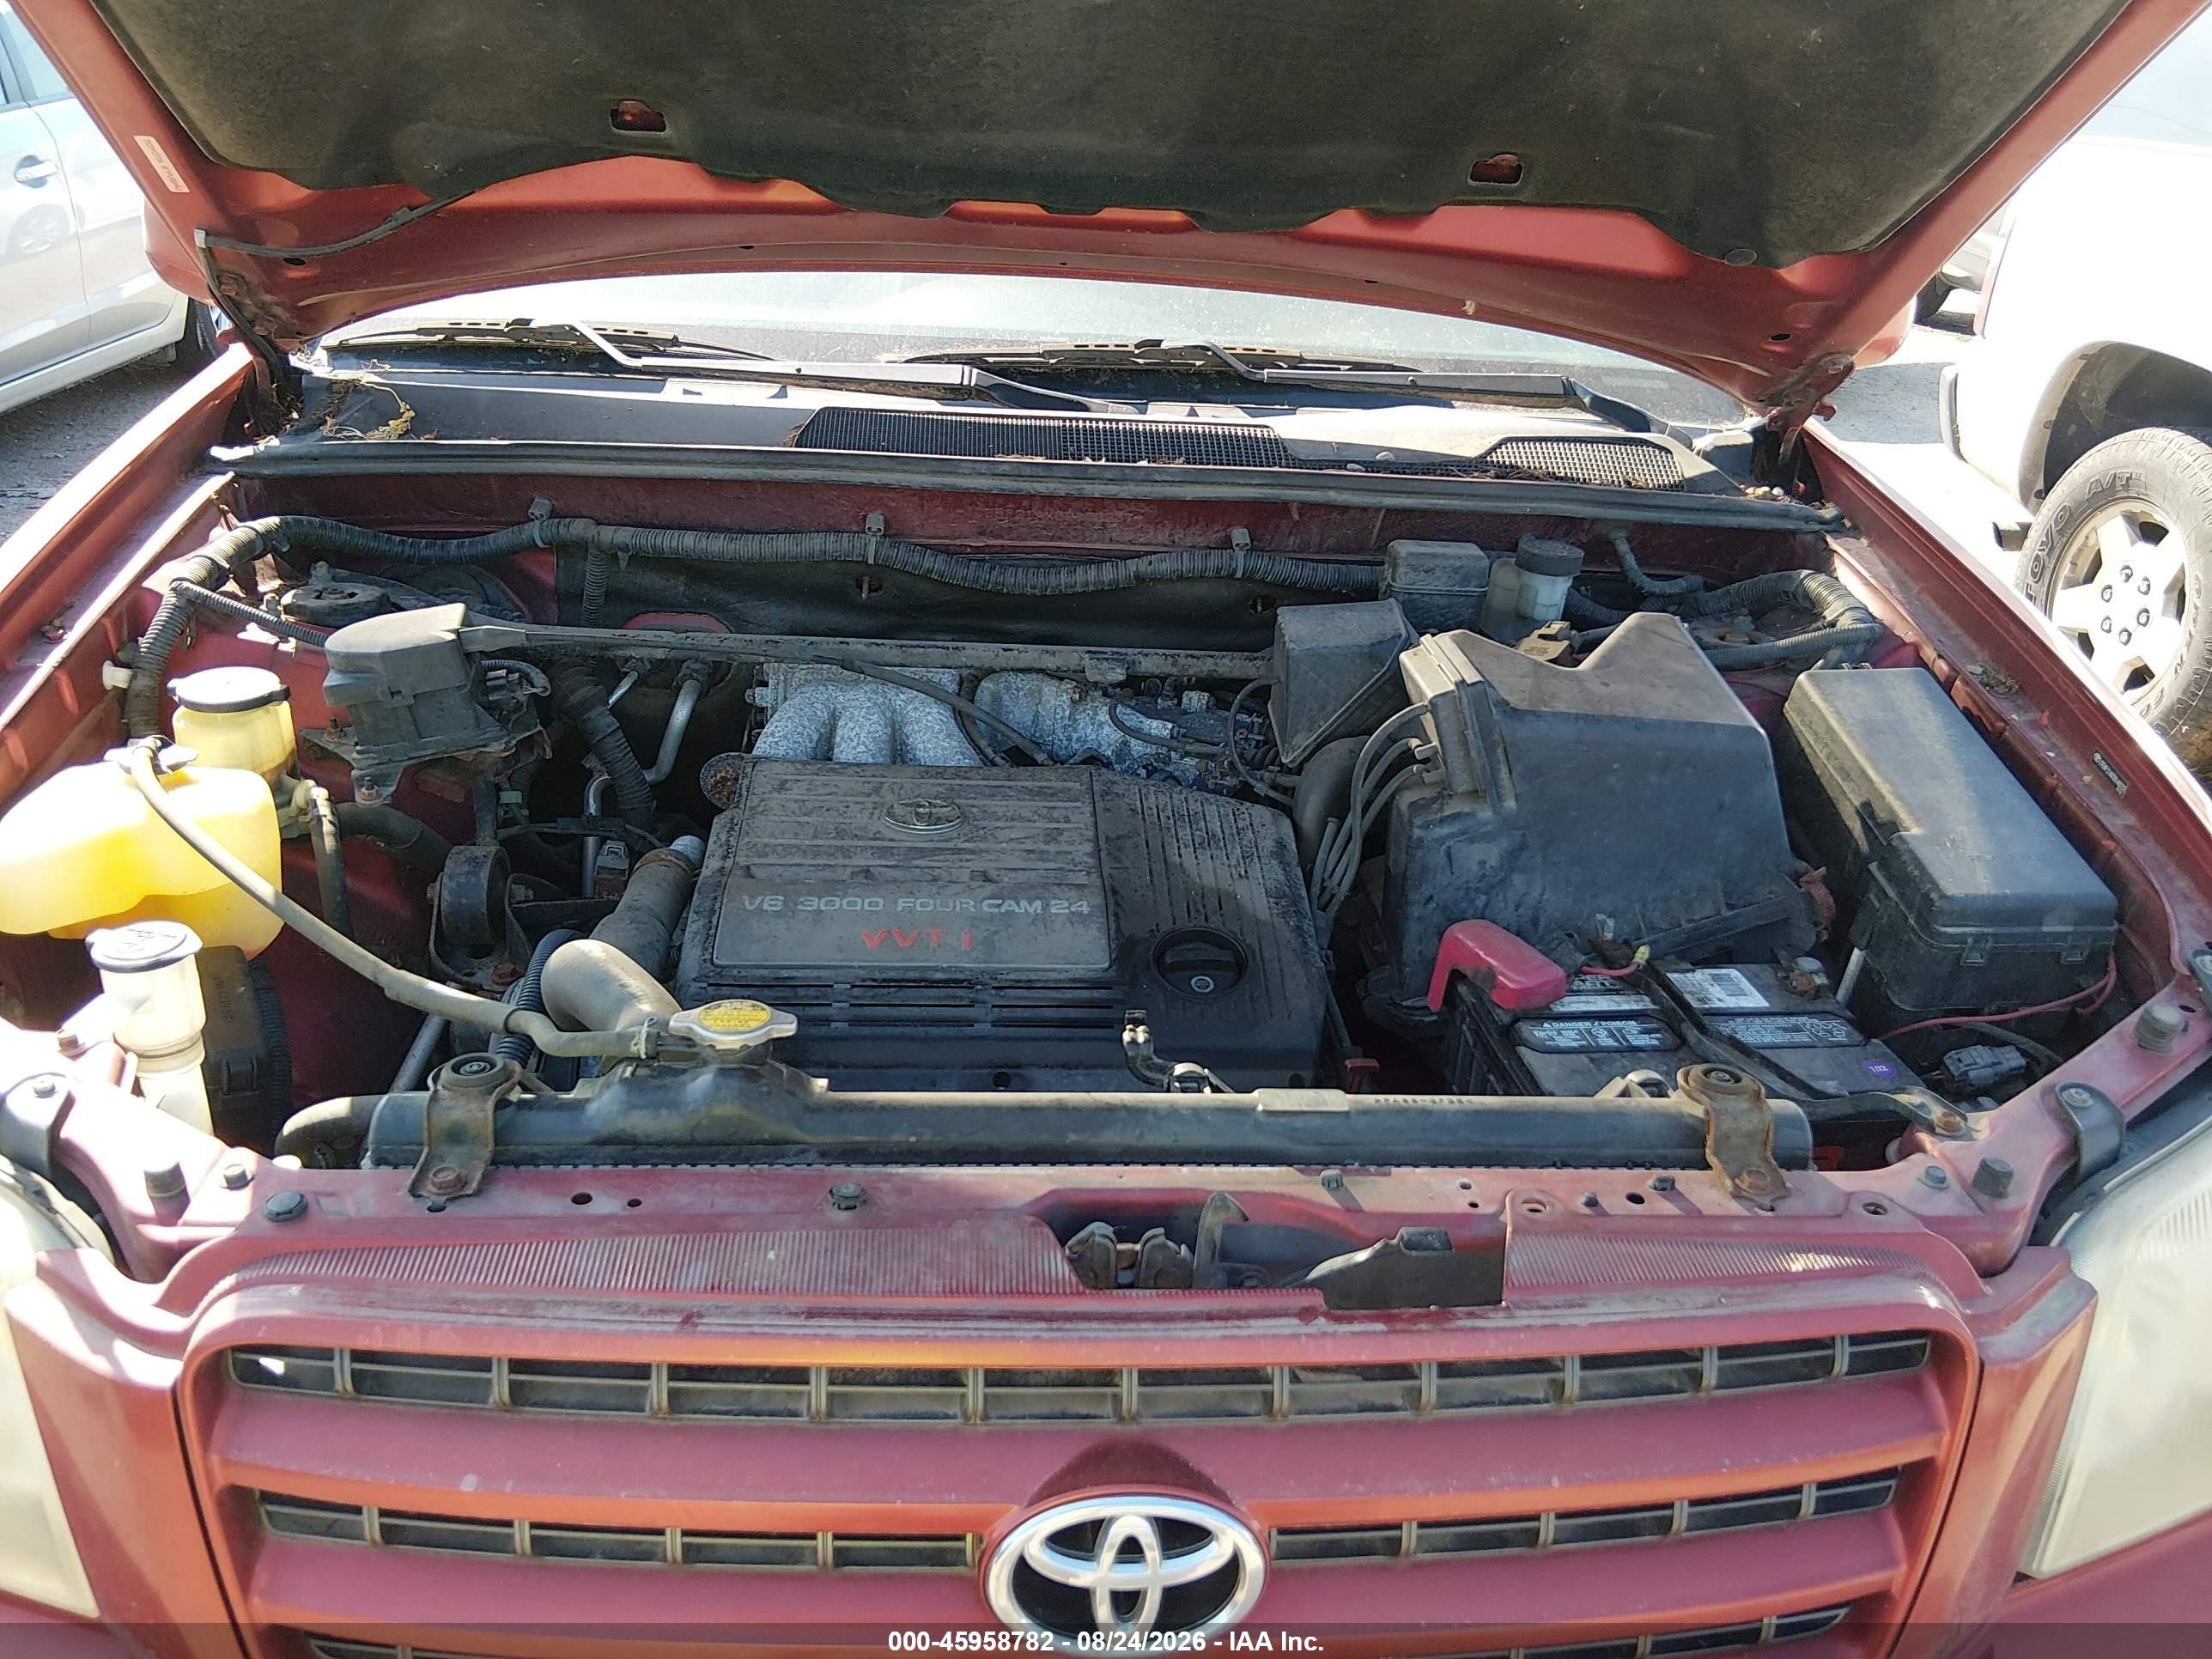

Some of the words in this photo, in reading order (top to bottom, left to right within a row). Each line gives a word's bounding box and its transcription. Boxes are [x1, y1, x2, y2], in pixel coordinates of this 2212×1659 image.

[741, 895, 785, 911] V6
[797, 896, 884, 911] 3000
[896, 897, 976, 913] FOUR
[981, 899, 1043, 915] CAM
[1050, 899, 1091, 915] 24
